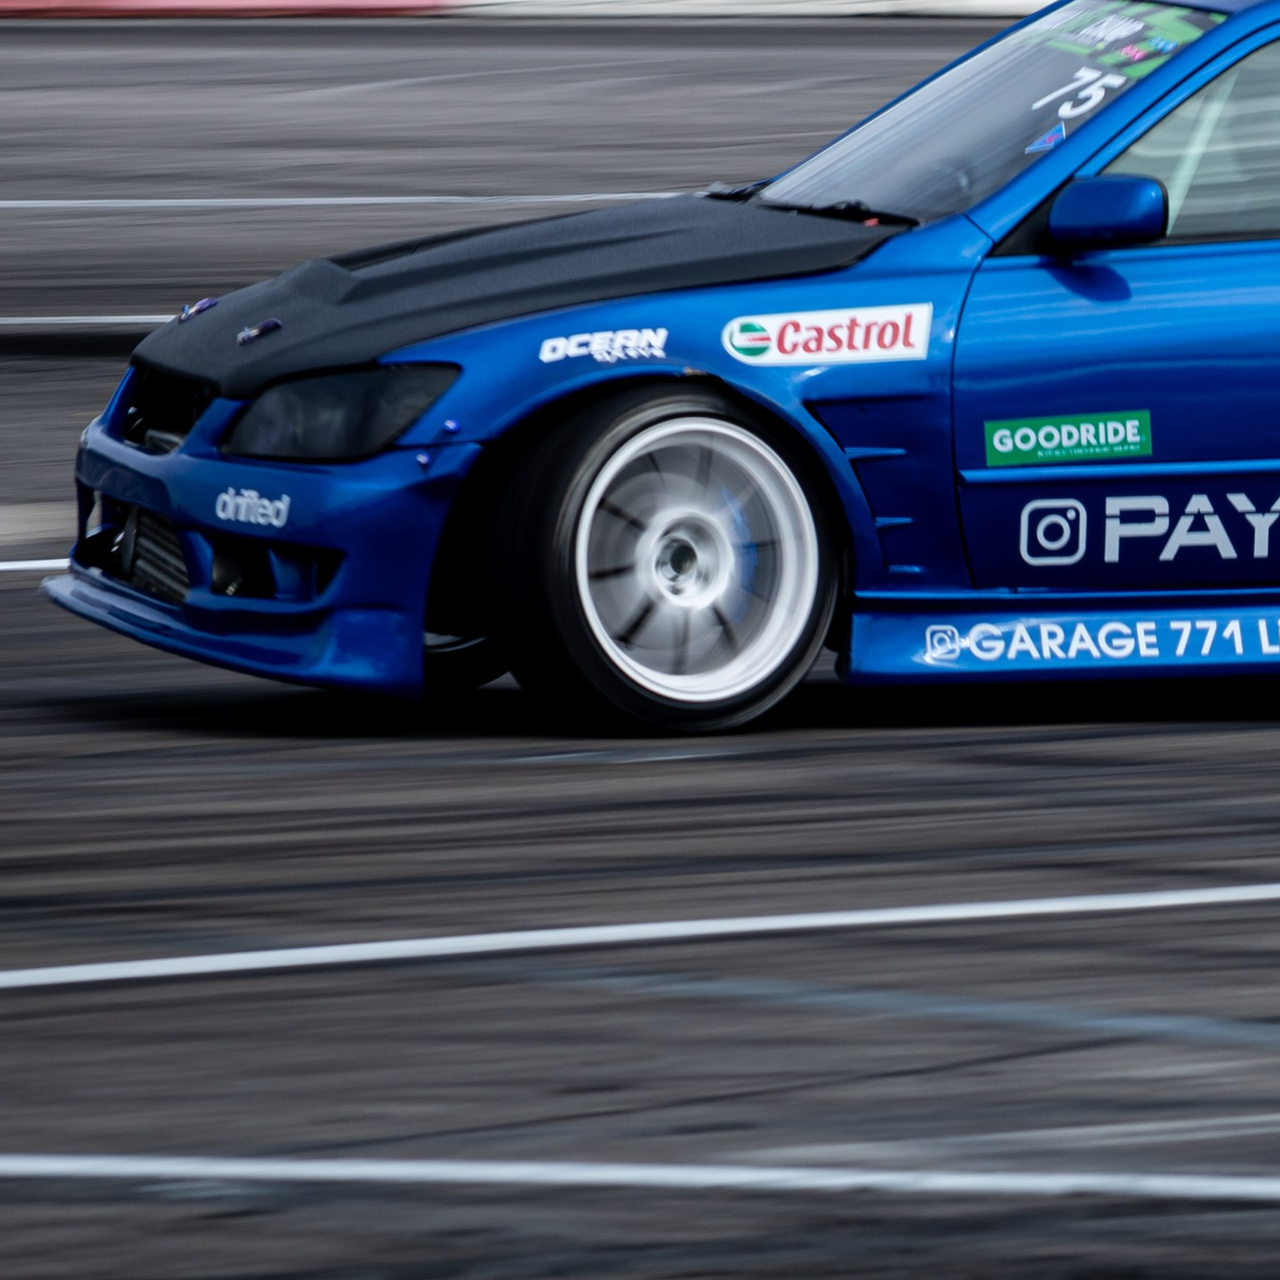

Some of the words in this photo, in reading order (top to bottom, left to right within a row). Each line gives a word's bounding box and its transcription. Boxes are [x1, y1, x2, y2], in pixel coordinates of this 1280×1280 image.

[1031, 66, 1127, 119] 75
[538, 327, 669, 363] OCEAN
[776, 312, 916, 356] Castrol
[992, 419, 1141, 453] GOODRIDE
[968, 622, 1160, 661] GARAGE
[1169, 619, 1245, 658] 771
